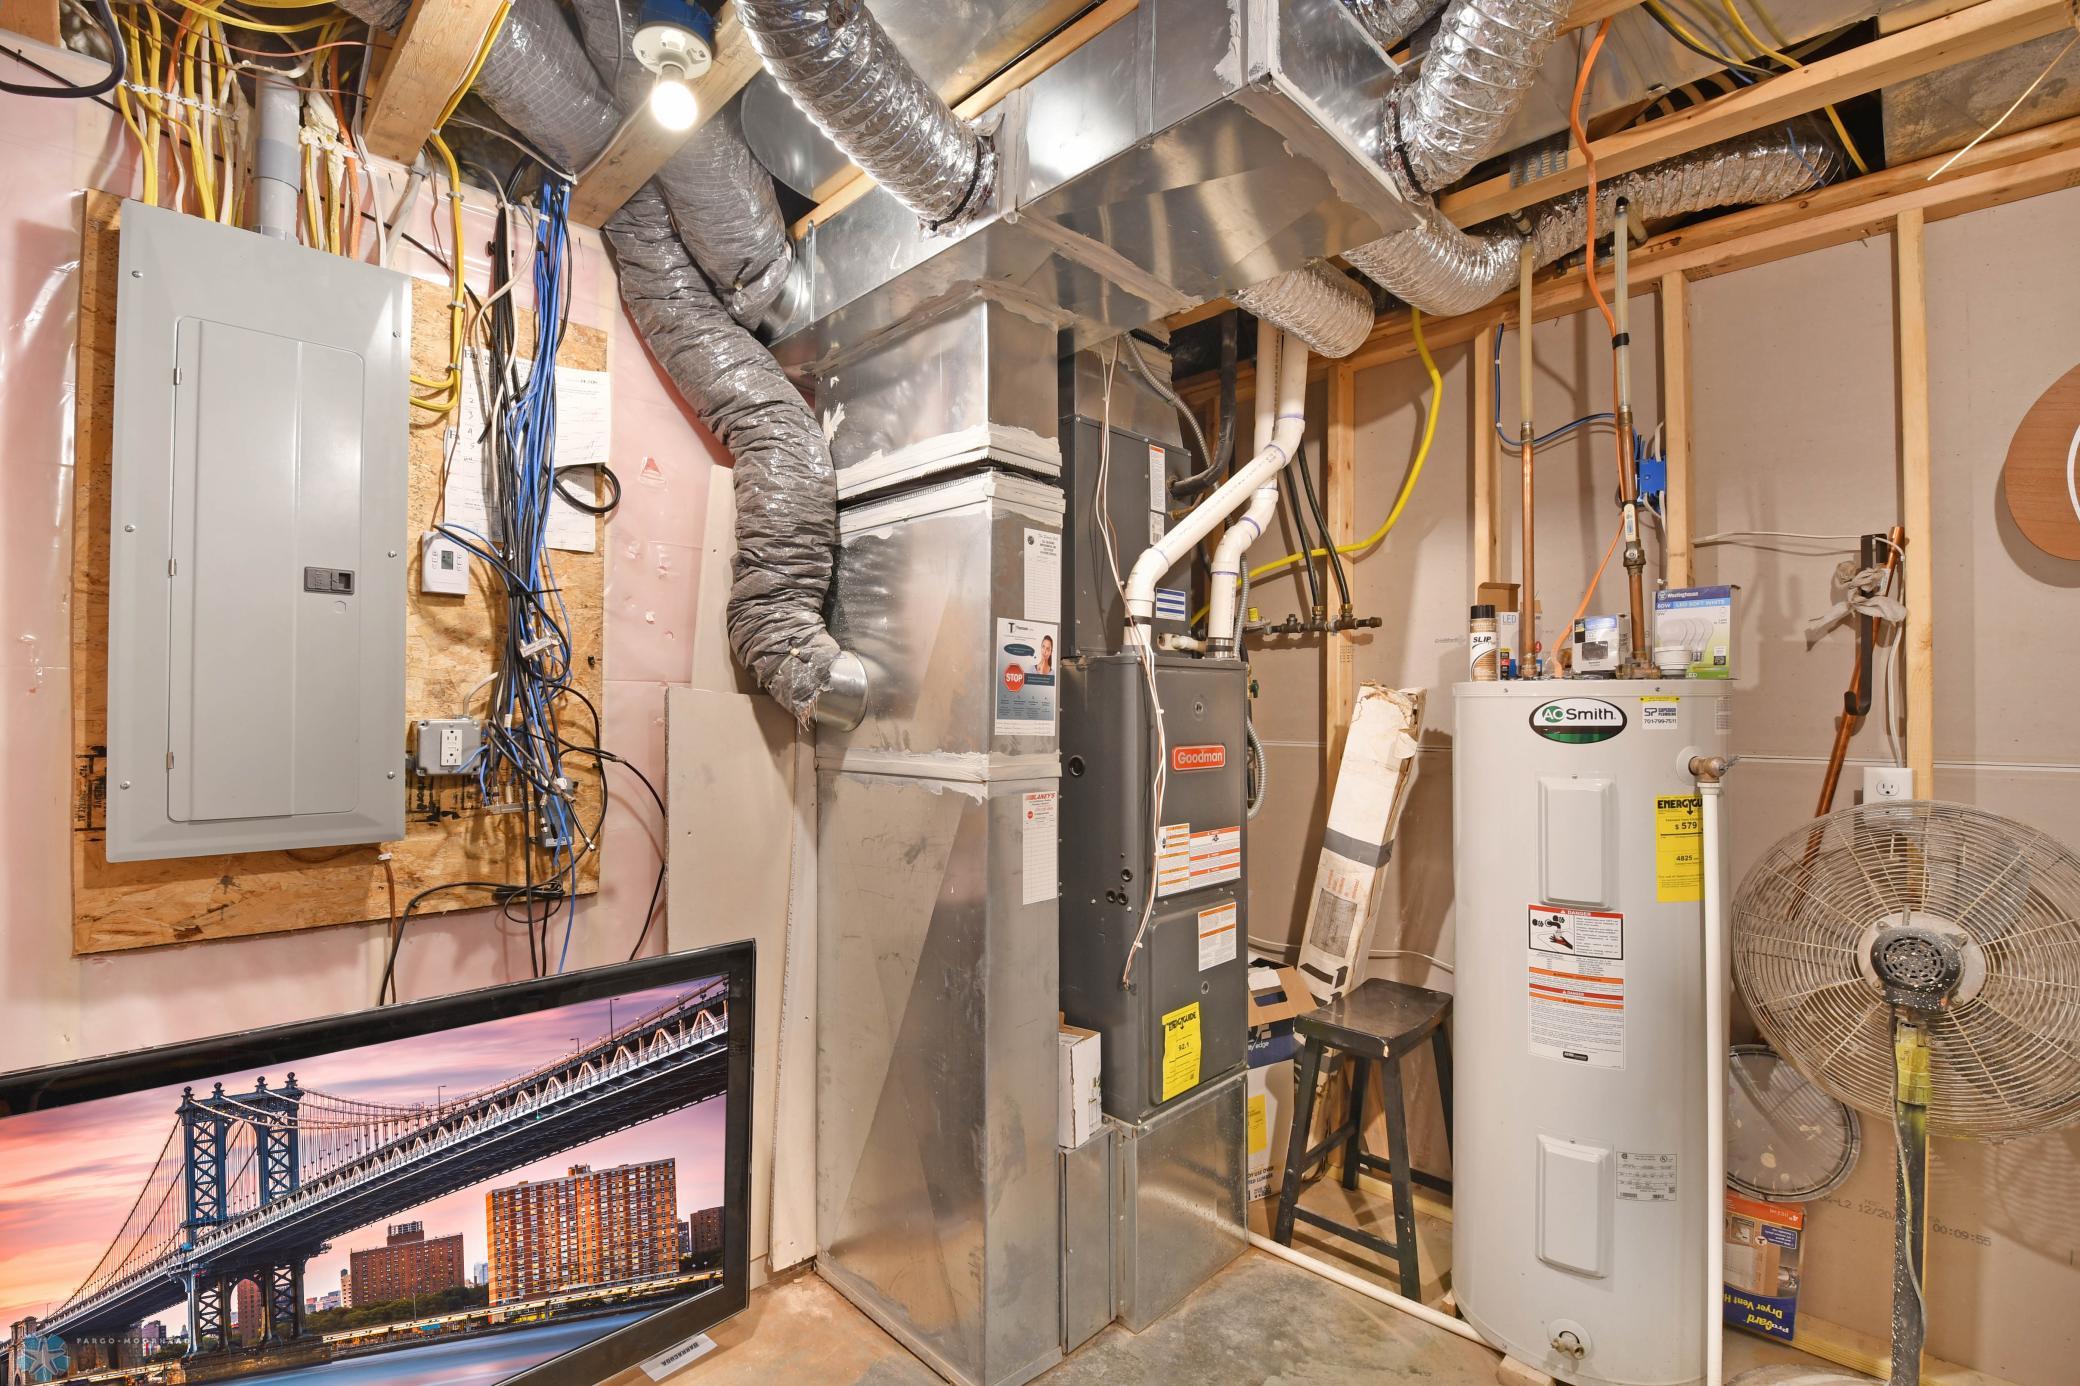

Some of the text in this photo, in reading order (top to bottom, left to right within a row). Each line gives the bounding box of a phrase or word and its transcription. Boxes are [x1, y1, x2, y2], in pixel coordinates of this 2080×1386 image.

[1502, 614, 1517, 625] LED
[1006, 672, 1023, 683] STOP
[1566, 708, 1614, 721] Smith
[1178, 751, 1223, 764] Goodman
[1657, 798, 1703, 809] ENERGYGU
[1681, 821, 1697, 830] 579
[1932, 1222, 1992, 1248] 00:09:55
[1733, 1295, 1755, 1311] Vent
[1756, 1302, 1783, 1320] Dryer
[661, 1342, 699, 1366] BARRACUDA
